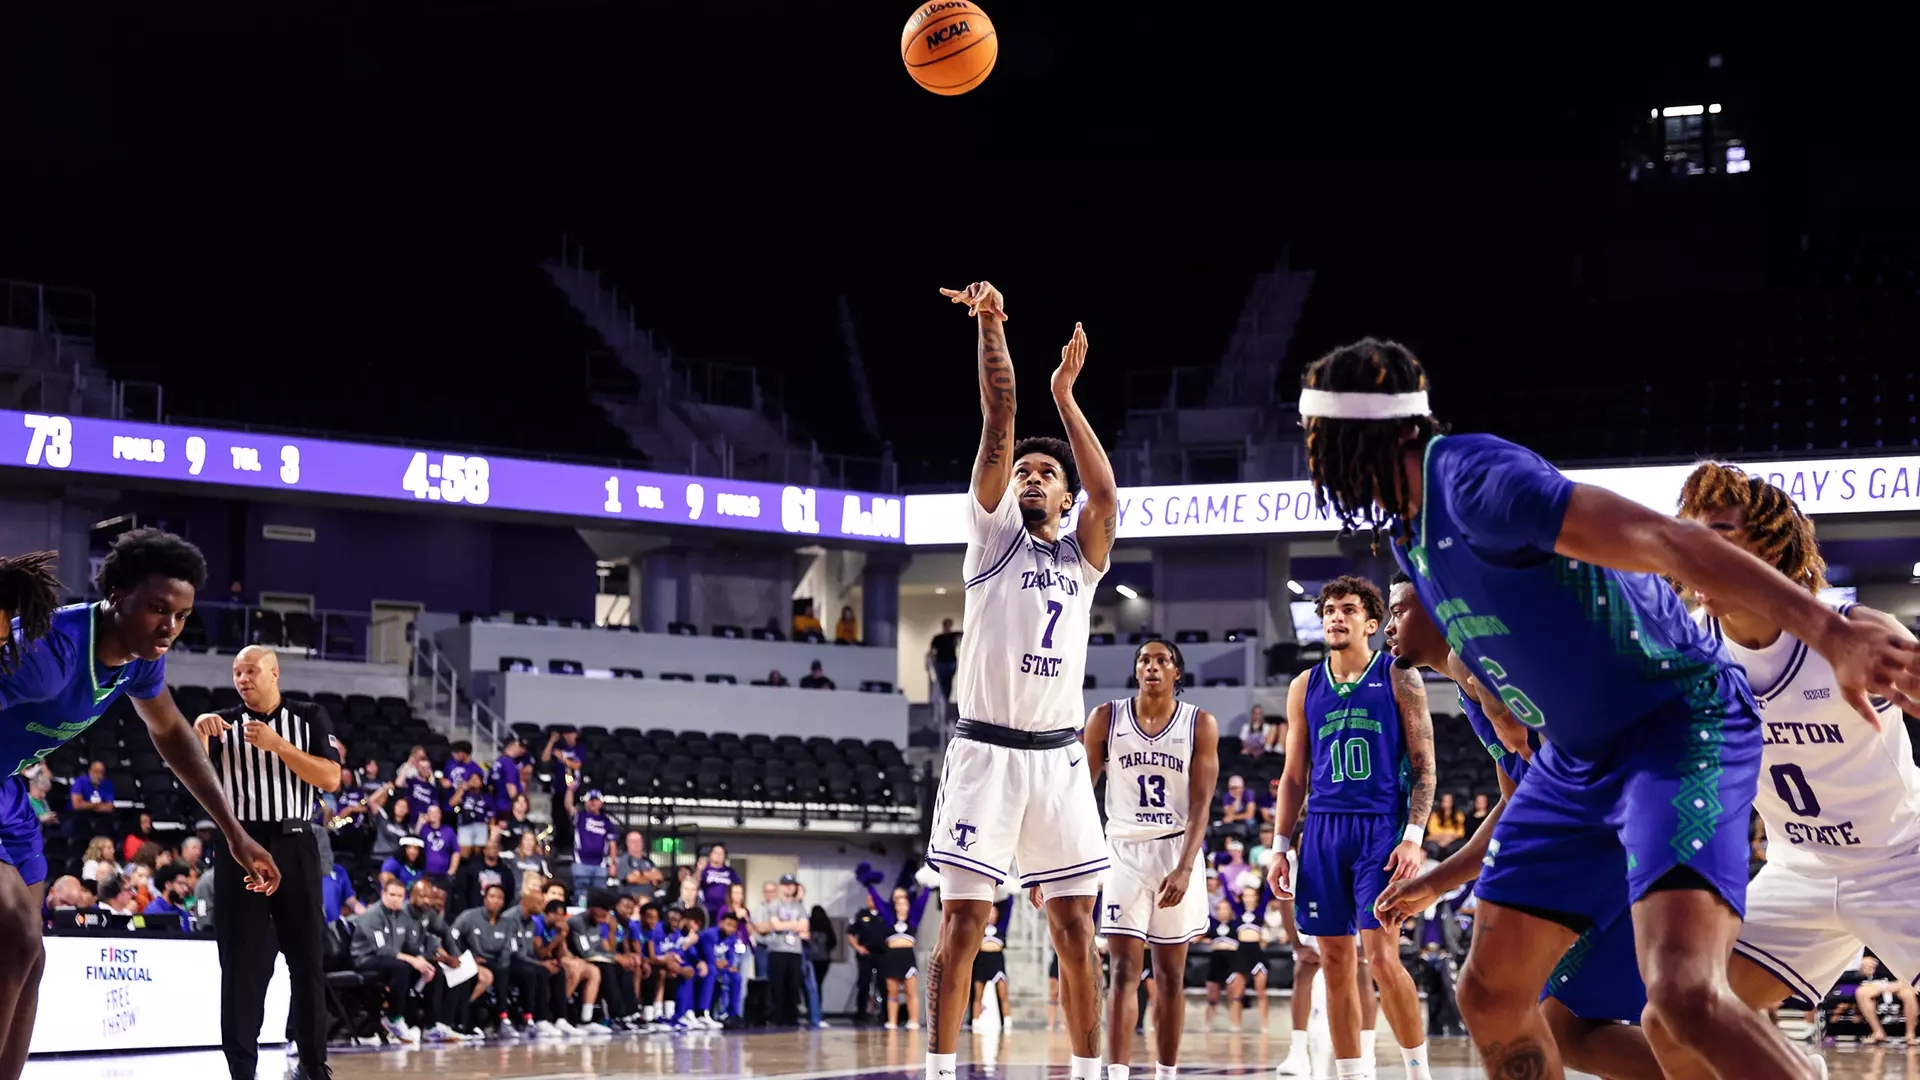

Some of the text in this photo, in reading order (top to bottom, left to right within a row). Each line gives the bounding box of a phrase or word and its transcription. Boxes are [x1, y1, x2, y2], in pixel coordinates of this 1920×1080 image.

[926, 20, 970, 50] NCAA
[24, 413, 72, 468] 73
[186, 437, 206, 475] 9
[280, 445, 300, 485] 3
[402, 452, 490, 504] 4:58
[604, 476, 622, 513] 1
[686, 483, 704, 520] 9
[781, 486, 820, 534] 61
[1749, 467, 1920, 501] DAY'S GA
[1165, 494, 1247, 526] GAME
[1041, 599, 1063, 649] 7
[1803, 688, 1830, 700] WAC
[1118, 751, 1184, 774] TARLETON
[1330, 736, 1372, 783] 10
[1137, 774, 1166, 808] 13
[1769, 762, 1821, 818] 0
[1135, 812, 1173, 825] STATE
[1785, 820, 1861, 846] STATE
[101, 947, 138, 963] FIRST
[86, 966, 152, 981] FINANCIAL
